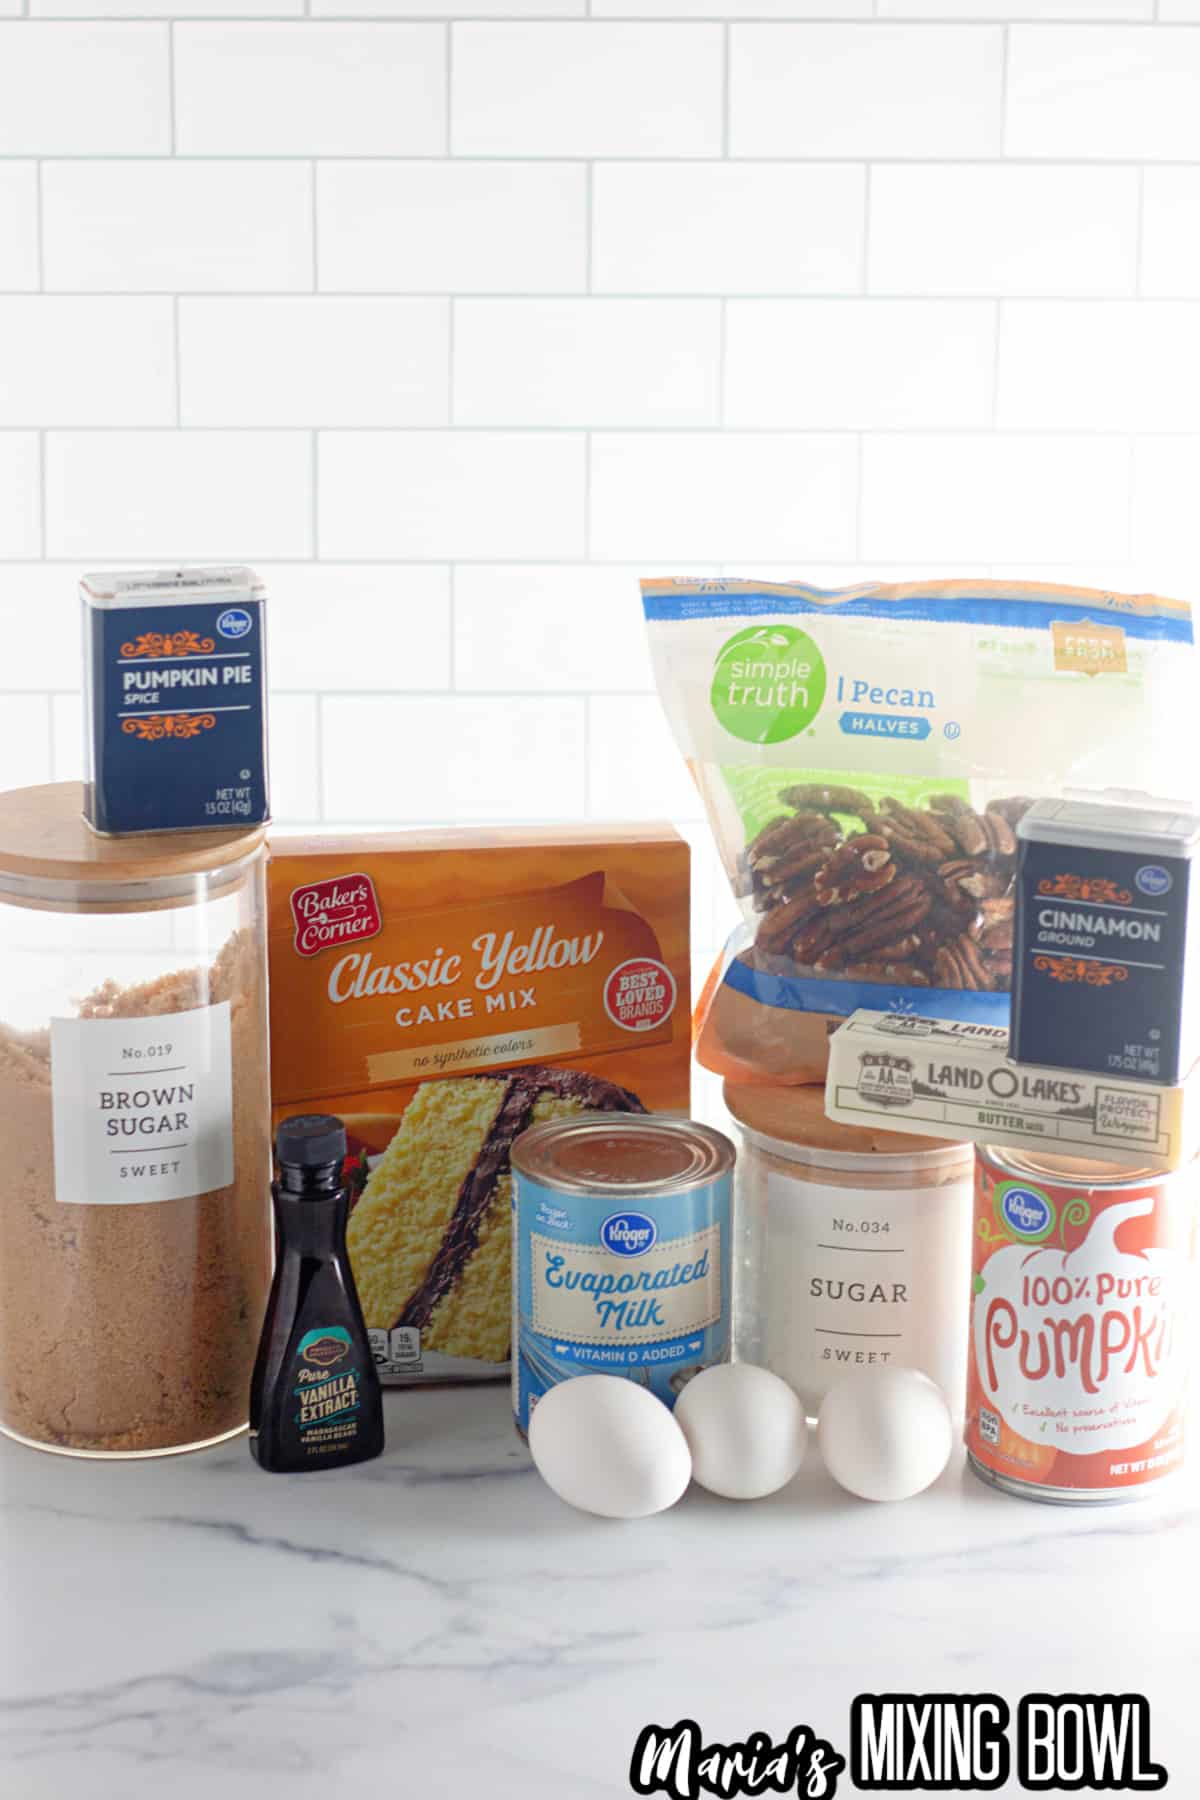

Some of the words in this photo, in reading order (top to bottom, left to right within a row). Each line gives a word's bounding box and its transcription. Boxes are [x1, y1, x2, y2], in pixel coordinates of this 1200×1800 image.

[123, 667, 218, 691] PUMPKIN
[223, 665, 252, 685] PIE
[731, 658, 812, 681] simple
[124, 692, 160, 704] SPICE
[728, 682, 809, 708] truth
[852, 680, 936, 708] Pecan
[852, 717, 919, 735] HALVES
[216, 789, 234, 800] NET
[235, 787, 251, 799] WT
[298, 883, 369, 918] Baker's
[301, 914, 370, 949] Corner
[1038, 910, 1160, 942] CINNAMON
[1037, 931, 1095, 948] GROUND
[328, 948, 461, 1004] Classic
[472, 925, 604, 990] Yellow
[619, 970, 659, 991] BEST
[396, 998, 473, 1027] CAKE
[486, 987, 537, 1014] MIX
[616, 985, 666, 1007] LOVED
[619, 1000, 665, 1020] BRANDS
[951, 1023, 1008, 1038] LAND
[122, 1044, 173, 1059] No.019
[413, 1054, 430, 1067] no
[431, 1044, 491, 1071] synthetic
[493, 1037, 535, 1057] colors
[1125, 1044, 1142, 1057] NET
[1144, 1047, 1160, 1059] WT
[878, 1067, 895, 1085] AA
[927, 1063, 983, 1090] LAND
[988, 1068, 1019, 1099] O
[1022, 1079, 1084, 1105] LAKES
[100, 1084, 194, 1110] BROWN
[978, 1111, 1026, 1131] BUTTER
[1100, 1104, 1152, 1119] PROTECT
[107, 1112, 189, 1136] SUGAR
[120, 1161, 180, 1178] SWEET
[1008, 1196, 1043, 1227] Kroger
[608, 1219, 652, 1250] Kroger
[832, 1218, 890, 1233] No.034
[545, 1249, 710, 1301] Evaporated
[810, 1278, 908, 1303] SUGAR
[1022, 1275, 1091, 1306] 100%
[596, 1298, 665, 1330] Milk
[572, 1347, 625, 1362] VITAMIN
[628, 1349, 638, 1362] D
[642, 1345, 685, 1361] ADDED
[823, 1348, 891, 1364] SWEET
[298, 1369, 331, 1383] Pure
[300, 1374, 356, 1406] VANILLA
[300, 1391, 358, 1423] EXTRACT
[1110, 1463, 1129, 1475] NET
[1131, 1460, 1145, 1473] WT
